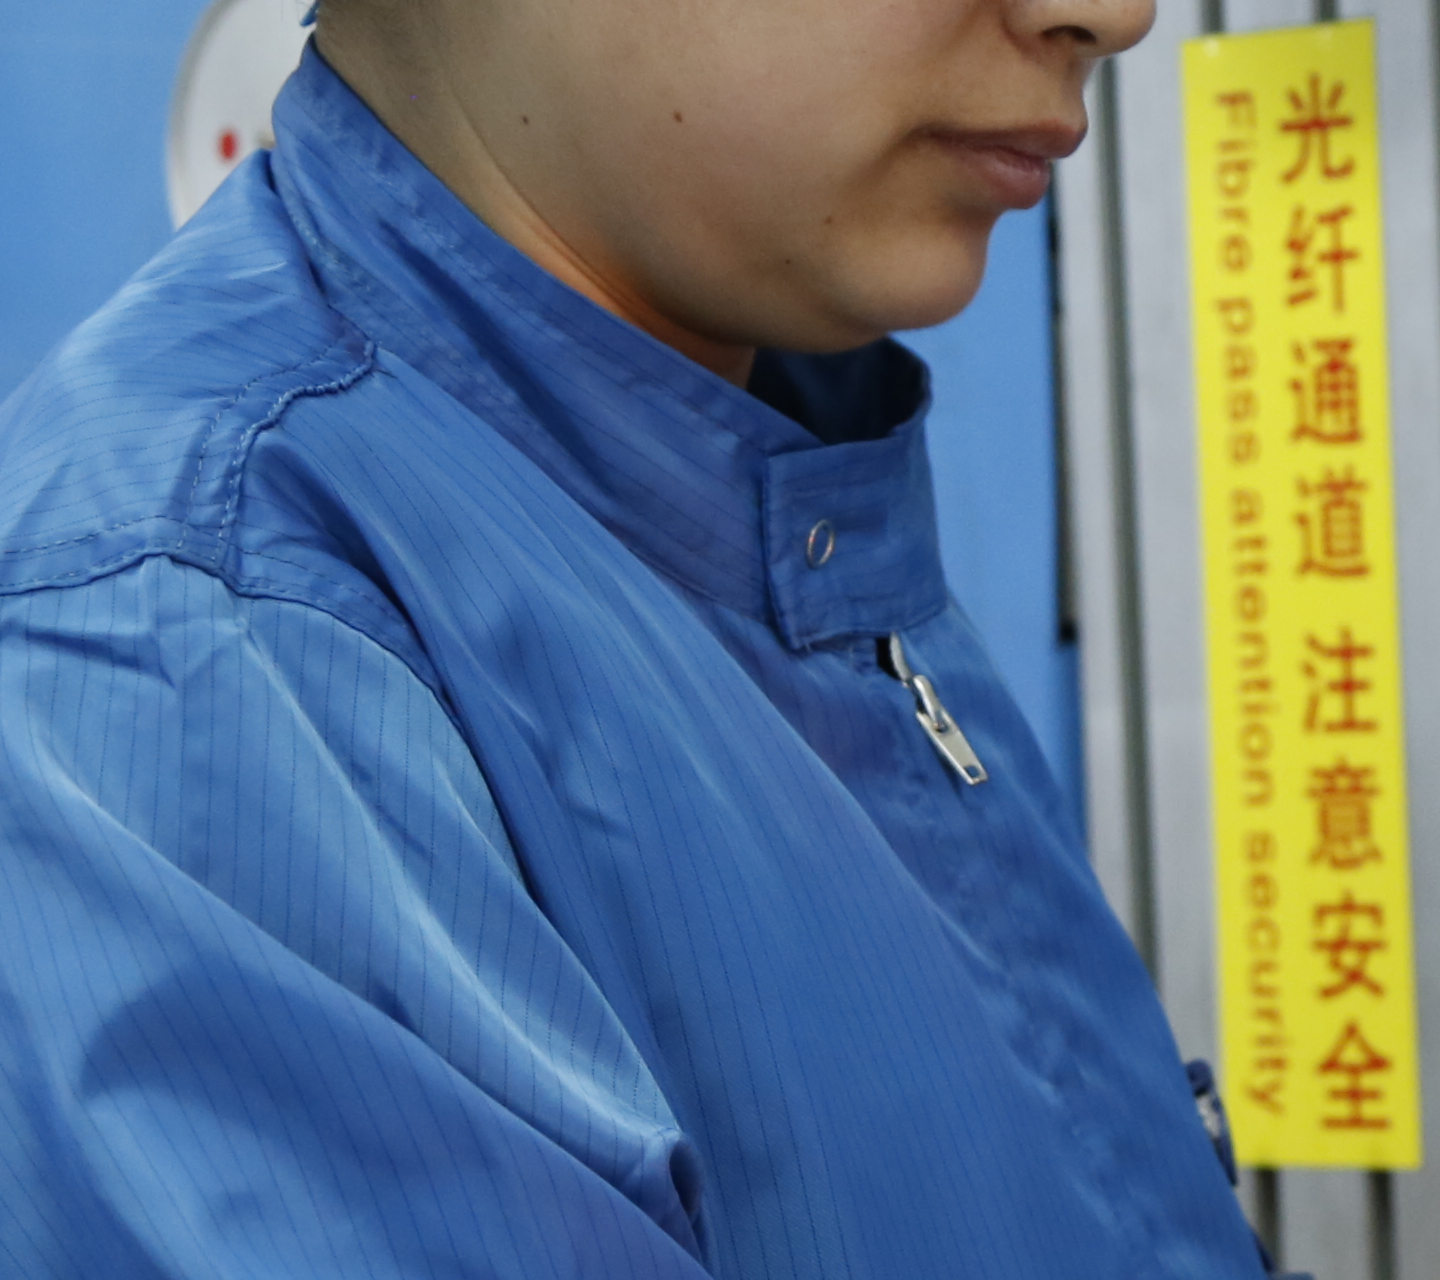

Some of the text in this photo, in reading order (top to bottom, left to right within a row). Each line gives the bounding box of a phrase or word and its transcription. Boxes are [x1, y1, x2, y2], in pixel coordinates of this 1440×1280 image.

[1213, 89, 1290, 1116] Fibre pass attention security
[1277, 71, 1394, 1135] 光纤通道 注意安全
